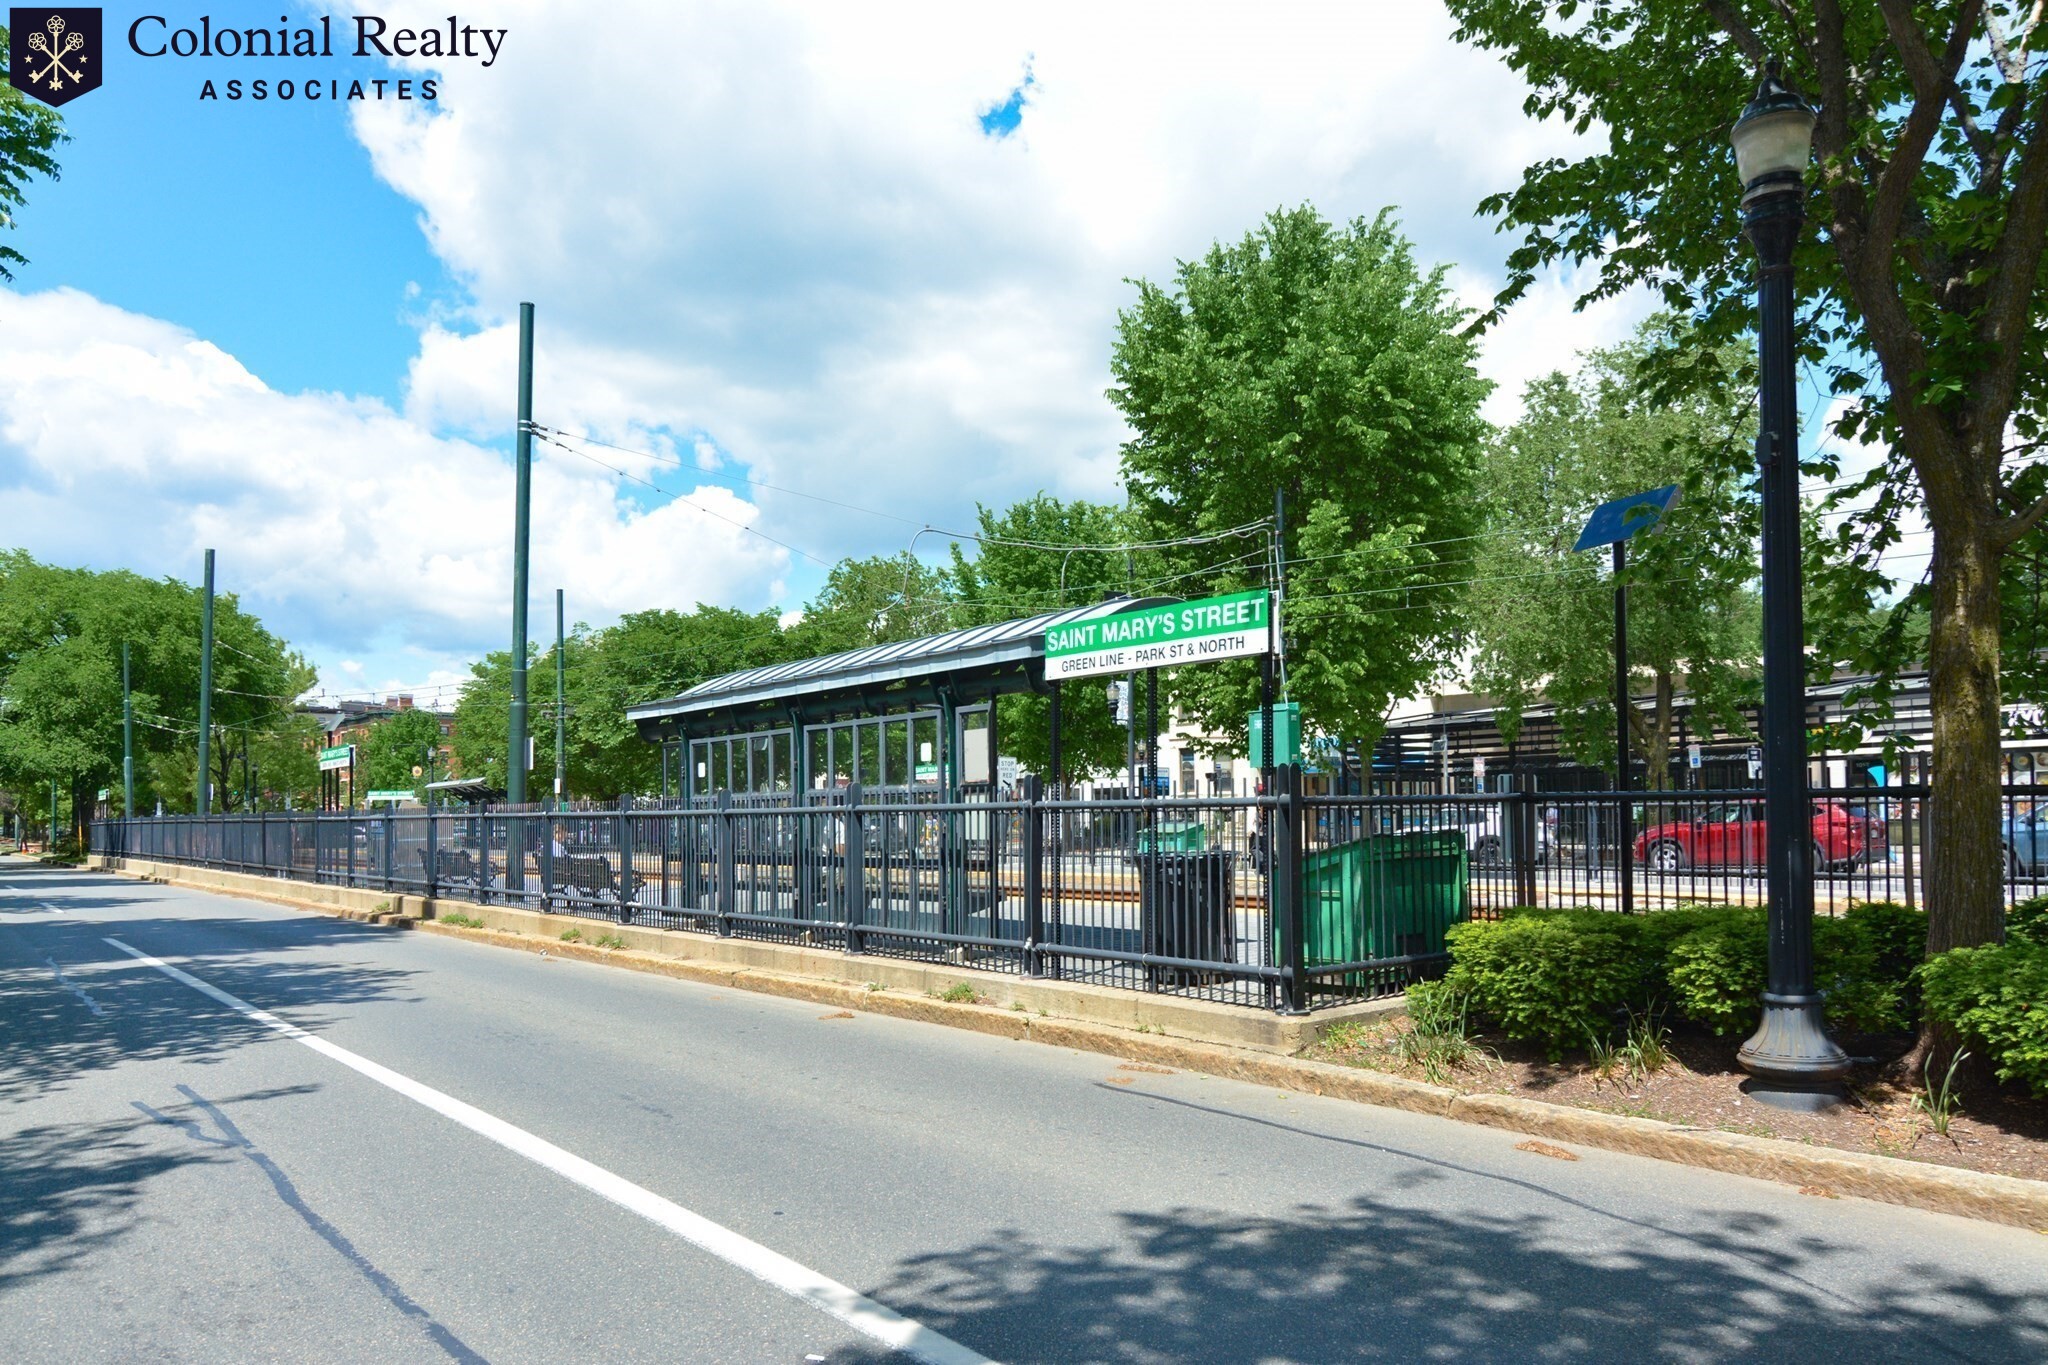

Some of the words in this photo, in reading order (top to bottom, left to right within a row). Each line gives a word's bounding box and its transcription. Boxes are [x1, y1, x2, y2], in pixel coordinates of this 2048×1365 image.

[1047, 625, 1096, 652] SAINT
[1102, 612, 1175, 644] MARY'S
[1181, 597, 1265, 632] STREET
[1061, 656, 1096, 673] GREEN
[1099, 652, 1124, 667] LINE
[1135, 646, 1166, 662] PARK
[1169, 644, 1184, 658] ST
[1187, 643, 1194, 656] &
[1199, 635, 1245, 654] NORTH
